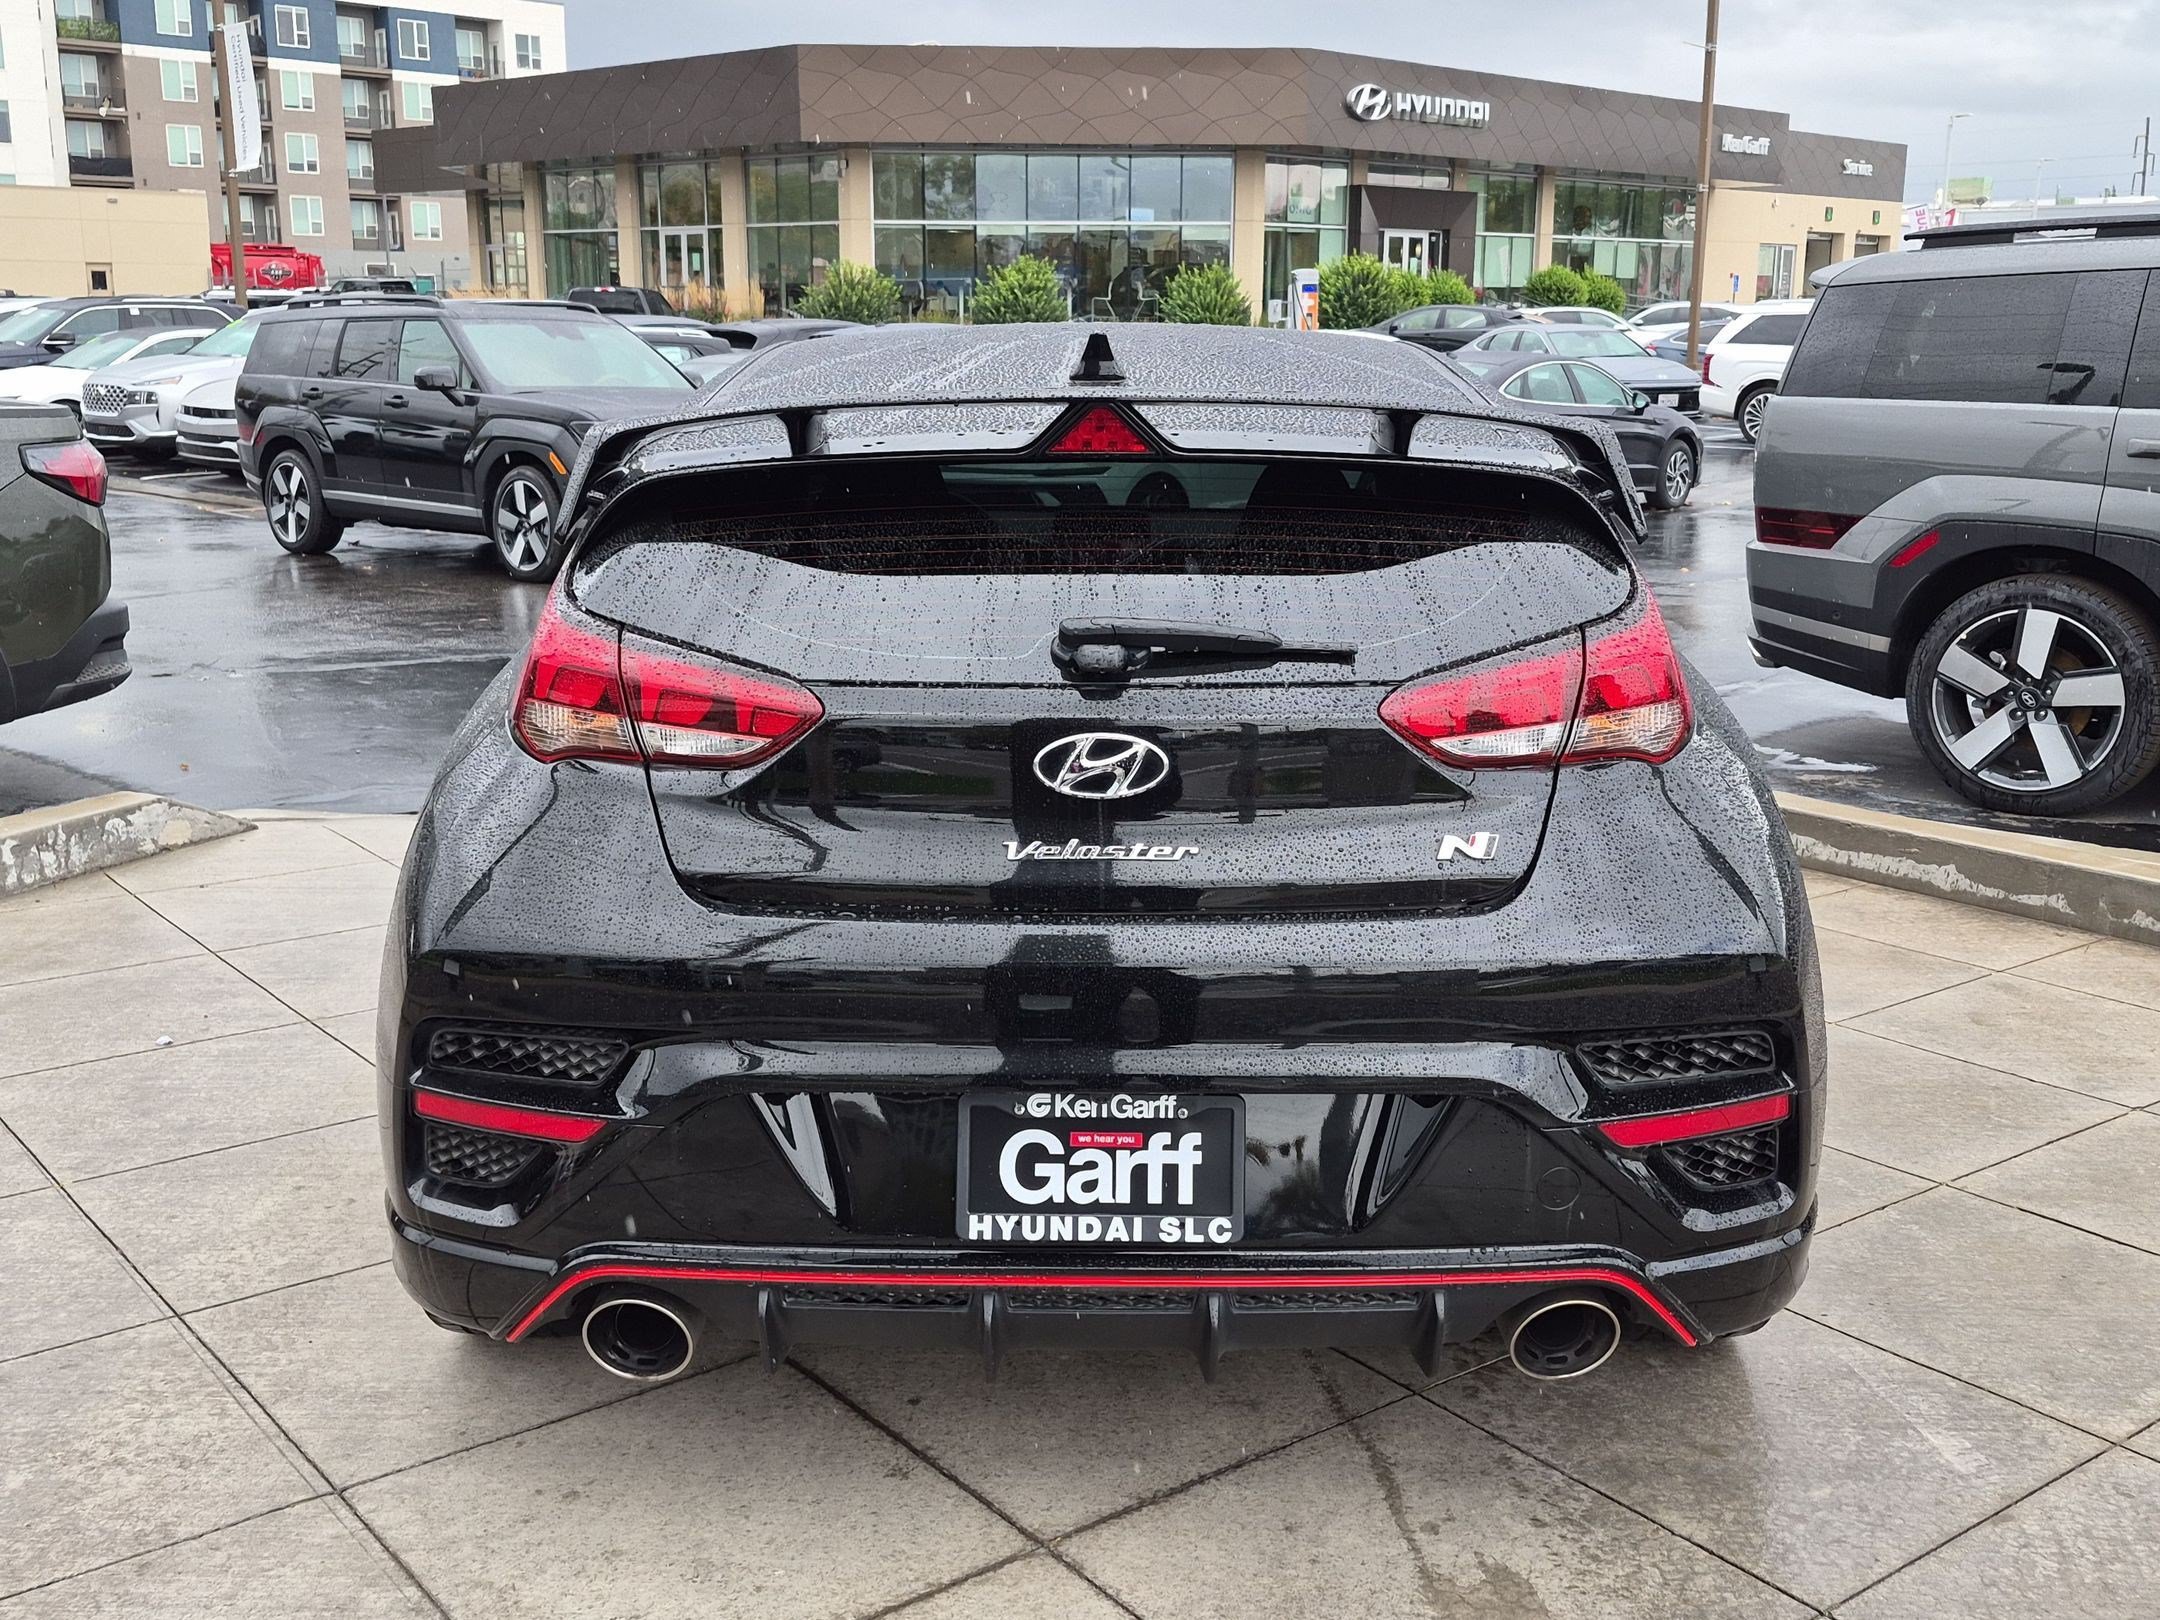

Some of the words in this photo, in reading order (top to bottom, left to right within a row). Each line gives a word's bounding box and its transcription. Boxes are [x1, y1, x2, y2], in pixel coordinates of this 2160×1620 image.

[231, 35, 241, 83] Certified
[235, 34, 246, 82] Hyundai
[236, 84, 245, 114] Used
[239, 115, 248, 161] Vehicles
[1843, 158, 1873, 176] Service
[1002, 838, 1199, 861] Veloster
[1054, 1093, 1108, 1118] Ken
[1110, 1093, 1177, 1119] Garff
[1077, 1135, 1092, 1143] we
[1093, 1133, 1115, 1143] hear
[1116, 1136, 1135, 1145] you
[999, 1128, 1203, 1205] Garff
[968, 1214, 1143, 1242] HYUNDAI
[1158, 1217, 1234, 1243] SLC
